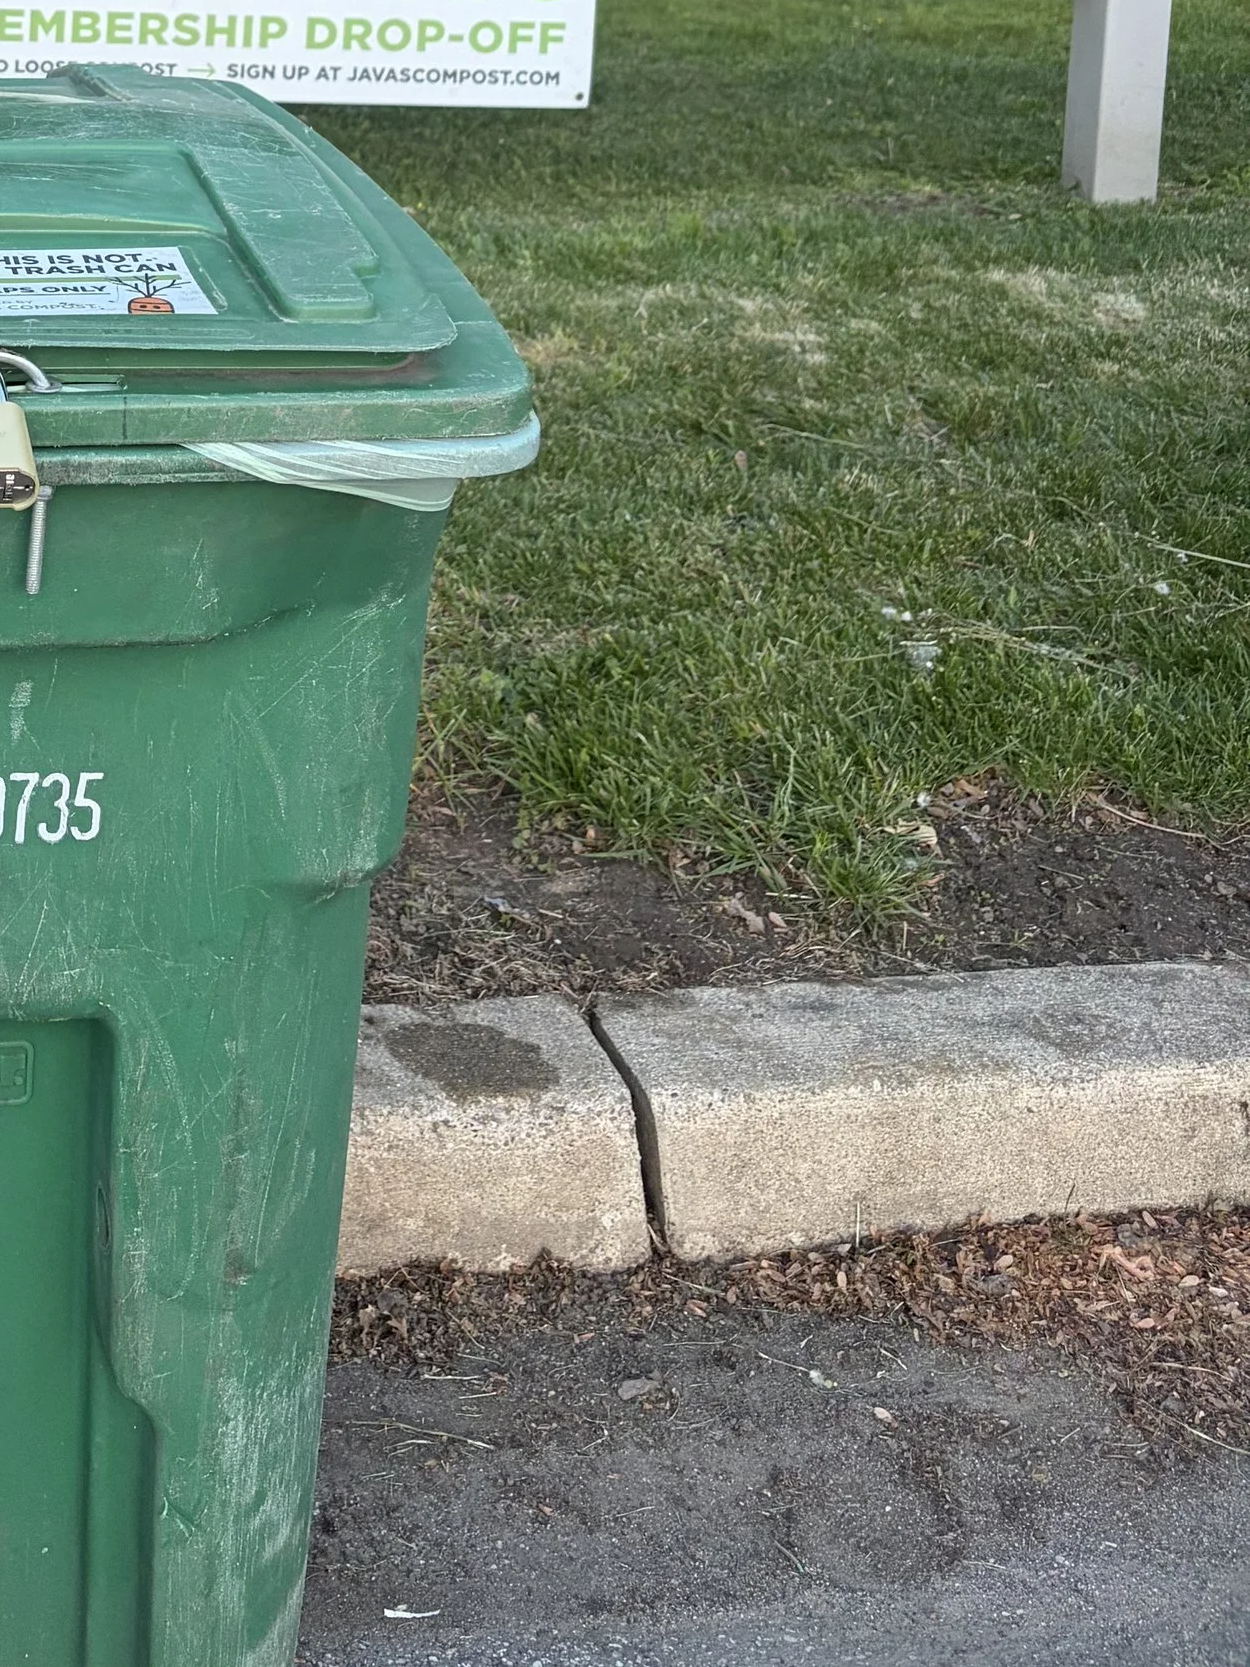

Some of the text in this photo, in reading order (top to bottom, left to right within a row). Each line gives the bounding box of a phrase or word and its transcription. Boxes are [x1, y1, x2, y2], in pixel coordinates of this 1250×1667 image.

[305, 17, 566, 54] DROP-OFF
[15, 59, 77, 74] LOOS
[227, 64, 560, 85] SIGN UP AT JAVASCOMPOST.COM
[48, 255, 73, 264] IS
[5, 264, 105, 275] TRASH
[114, 262, 177, 272] CAN
[42, 285, 109, 293] ONLY
